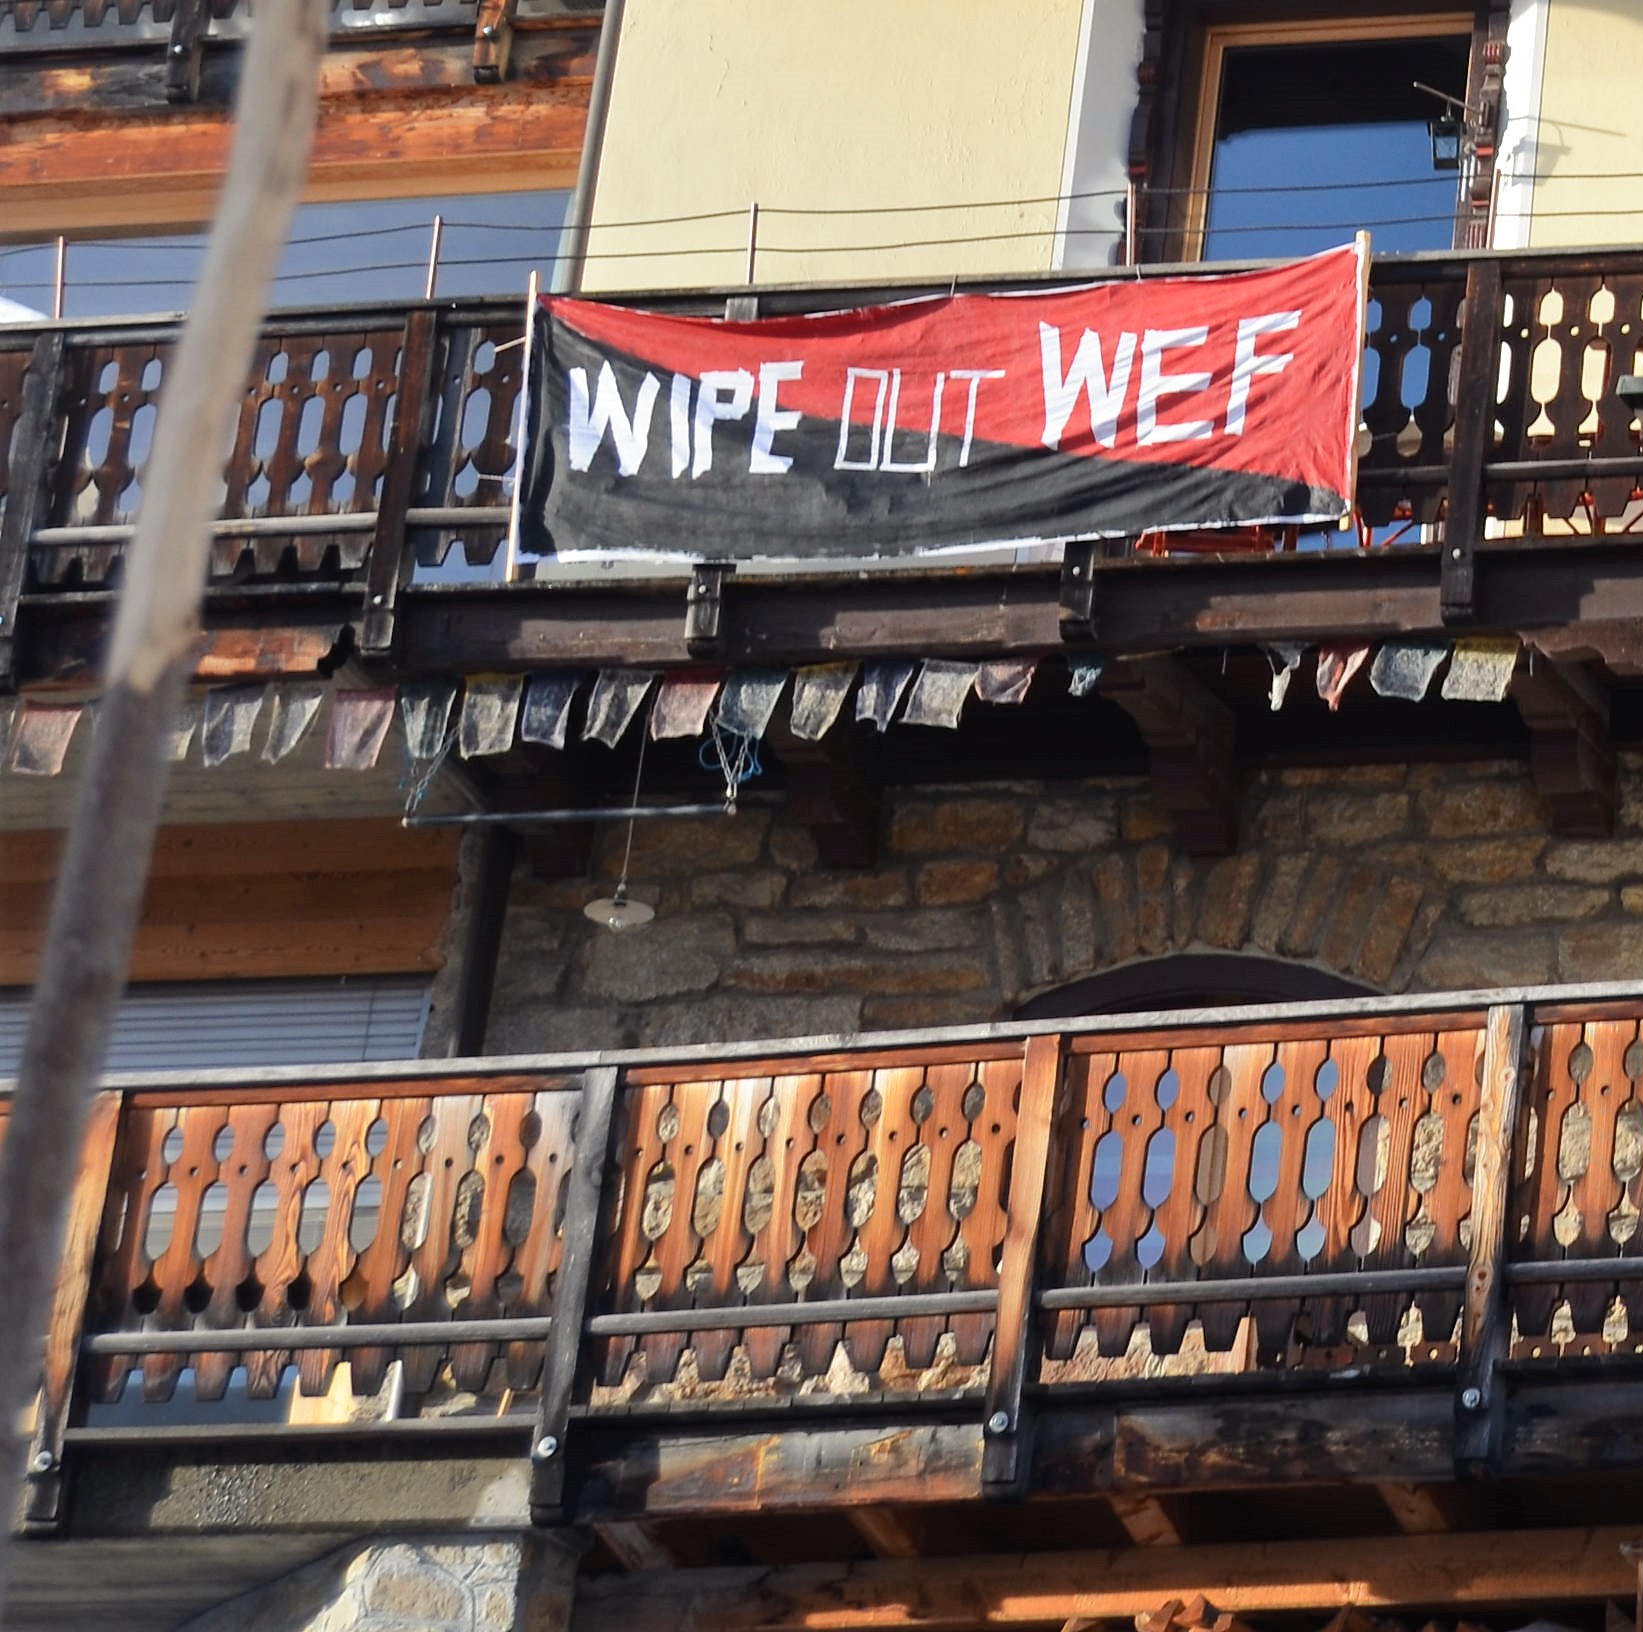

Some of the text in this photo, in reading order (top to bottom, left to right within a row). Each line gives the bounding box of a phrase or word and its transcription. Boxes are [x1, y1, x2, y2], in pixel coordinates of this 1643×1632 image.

[567, 309, 1302, 479] WIPE OUT WEF
